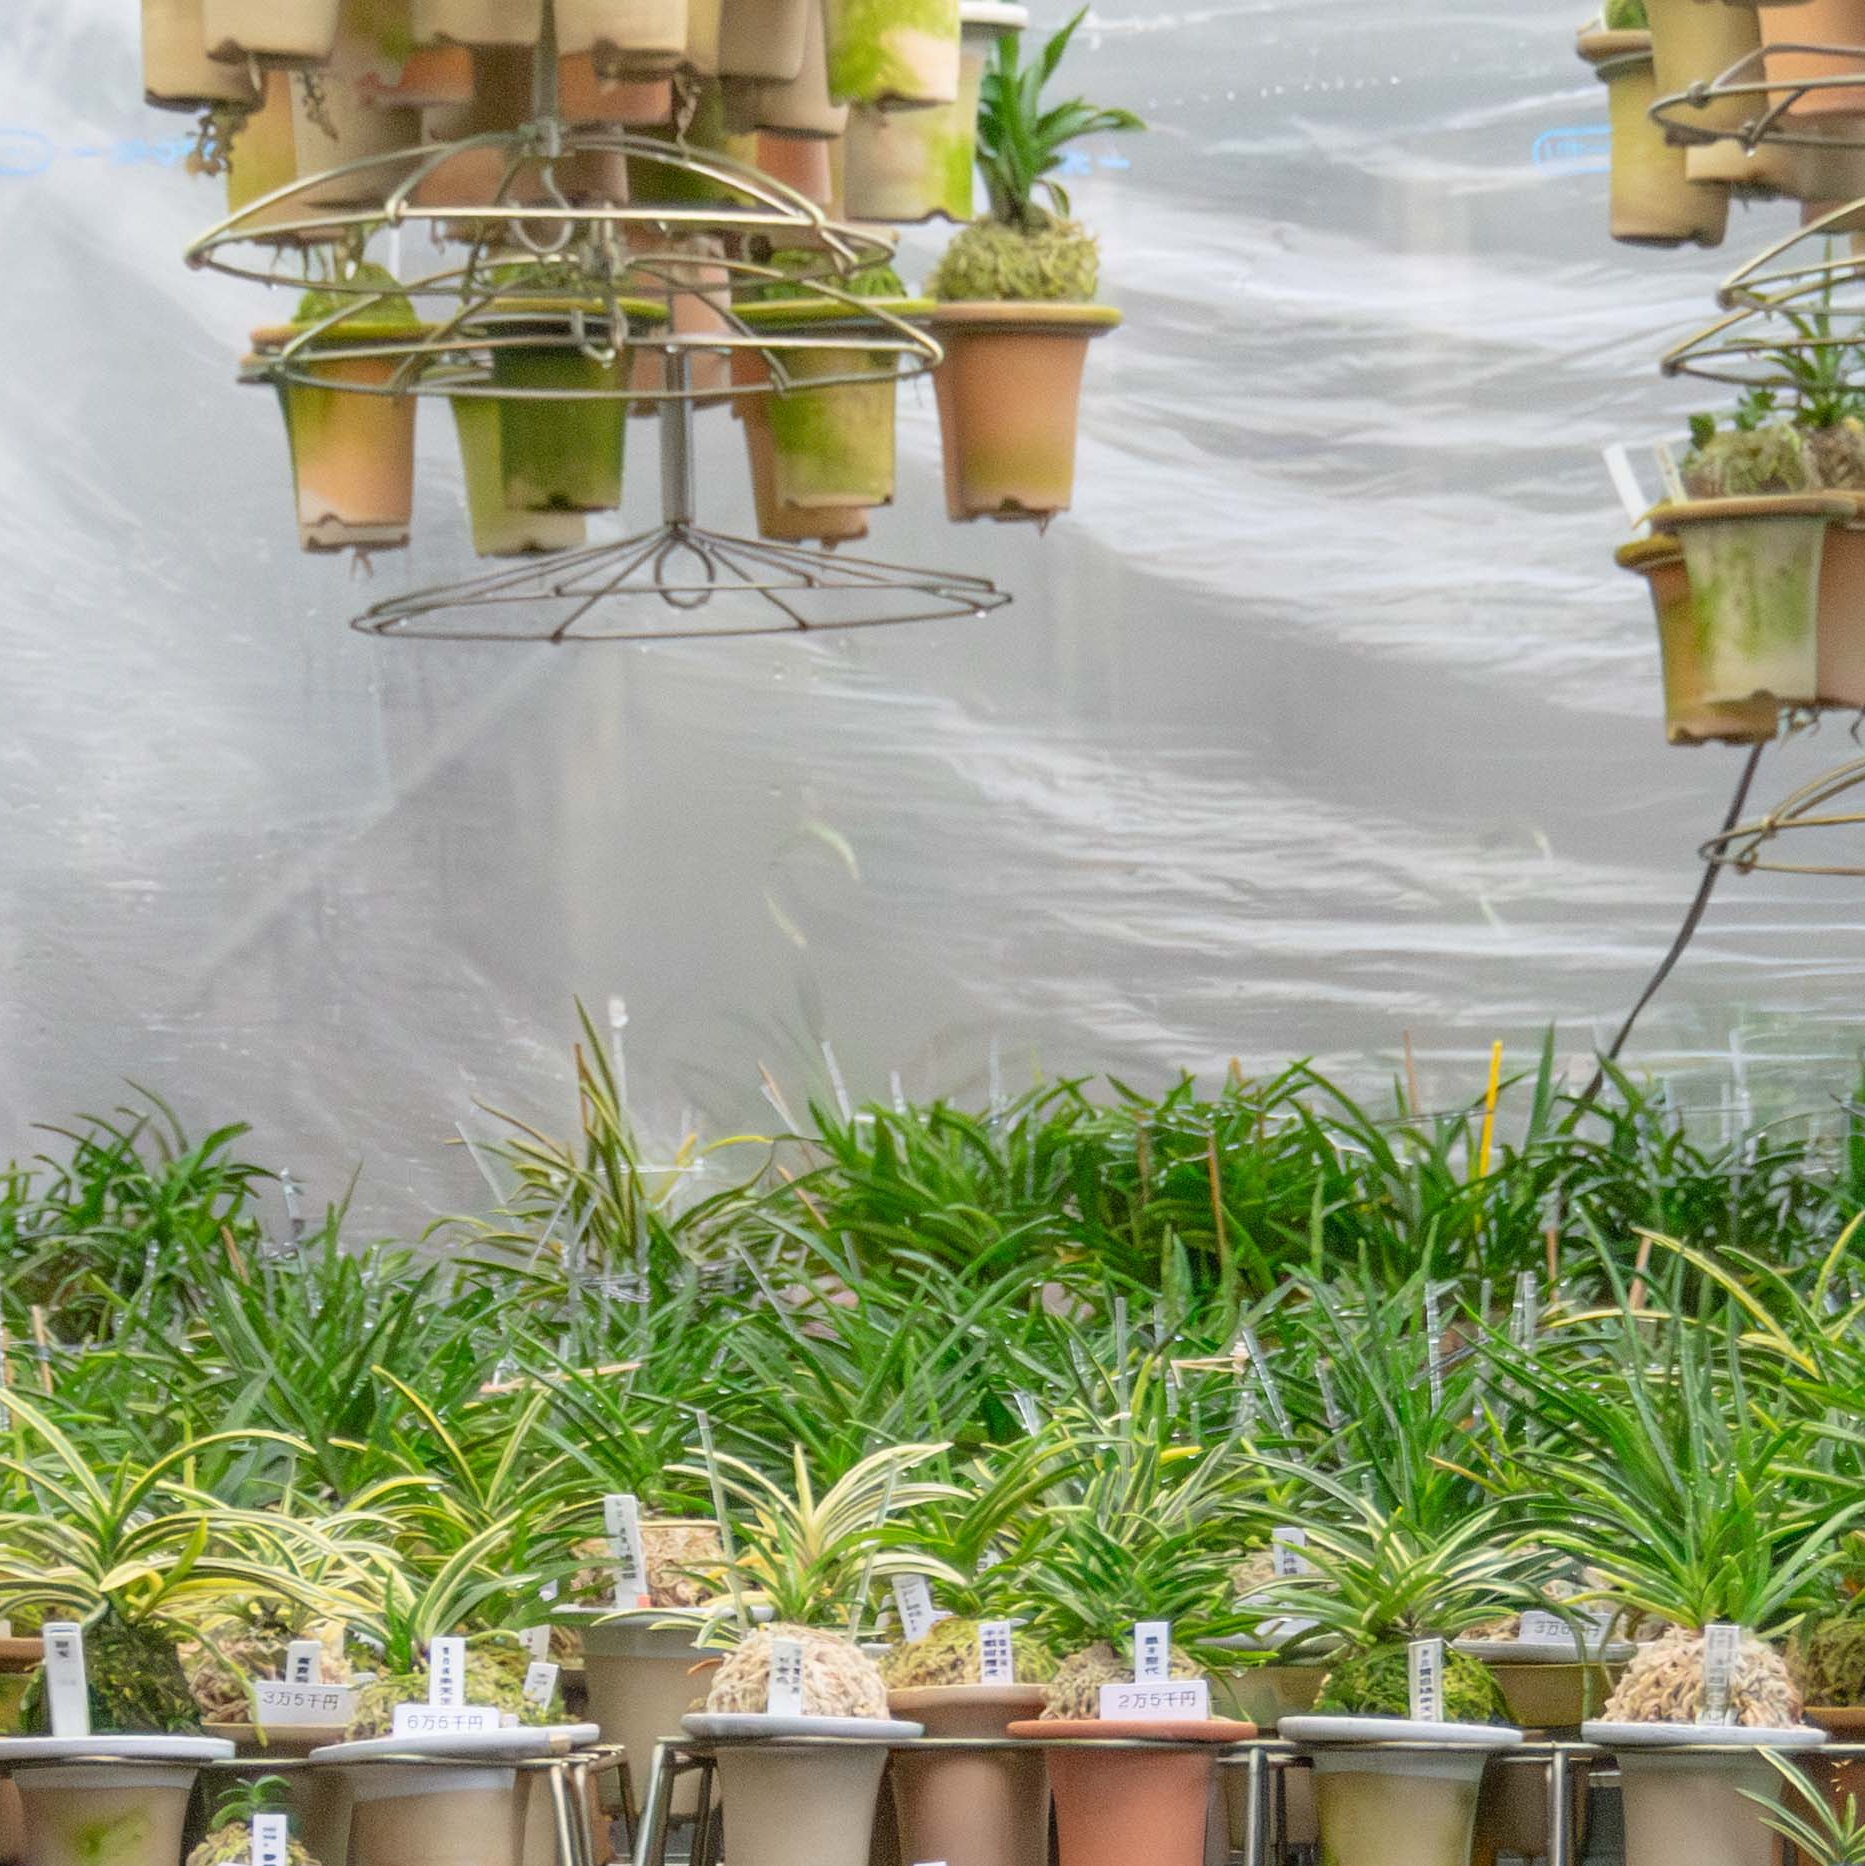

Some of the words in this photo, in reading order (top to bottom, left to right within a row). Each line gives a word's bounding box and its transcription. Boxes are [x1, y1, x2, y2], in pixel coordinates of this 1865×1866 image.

[262, 1690, 339, 1710] 3万5千円
[1118, 1690, 1196, 1709] 2万5千円
